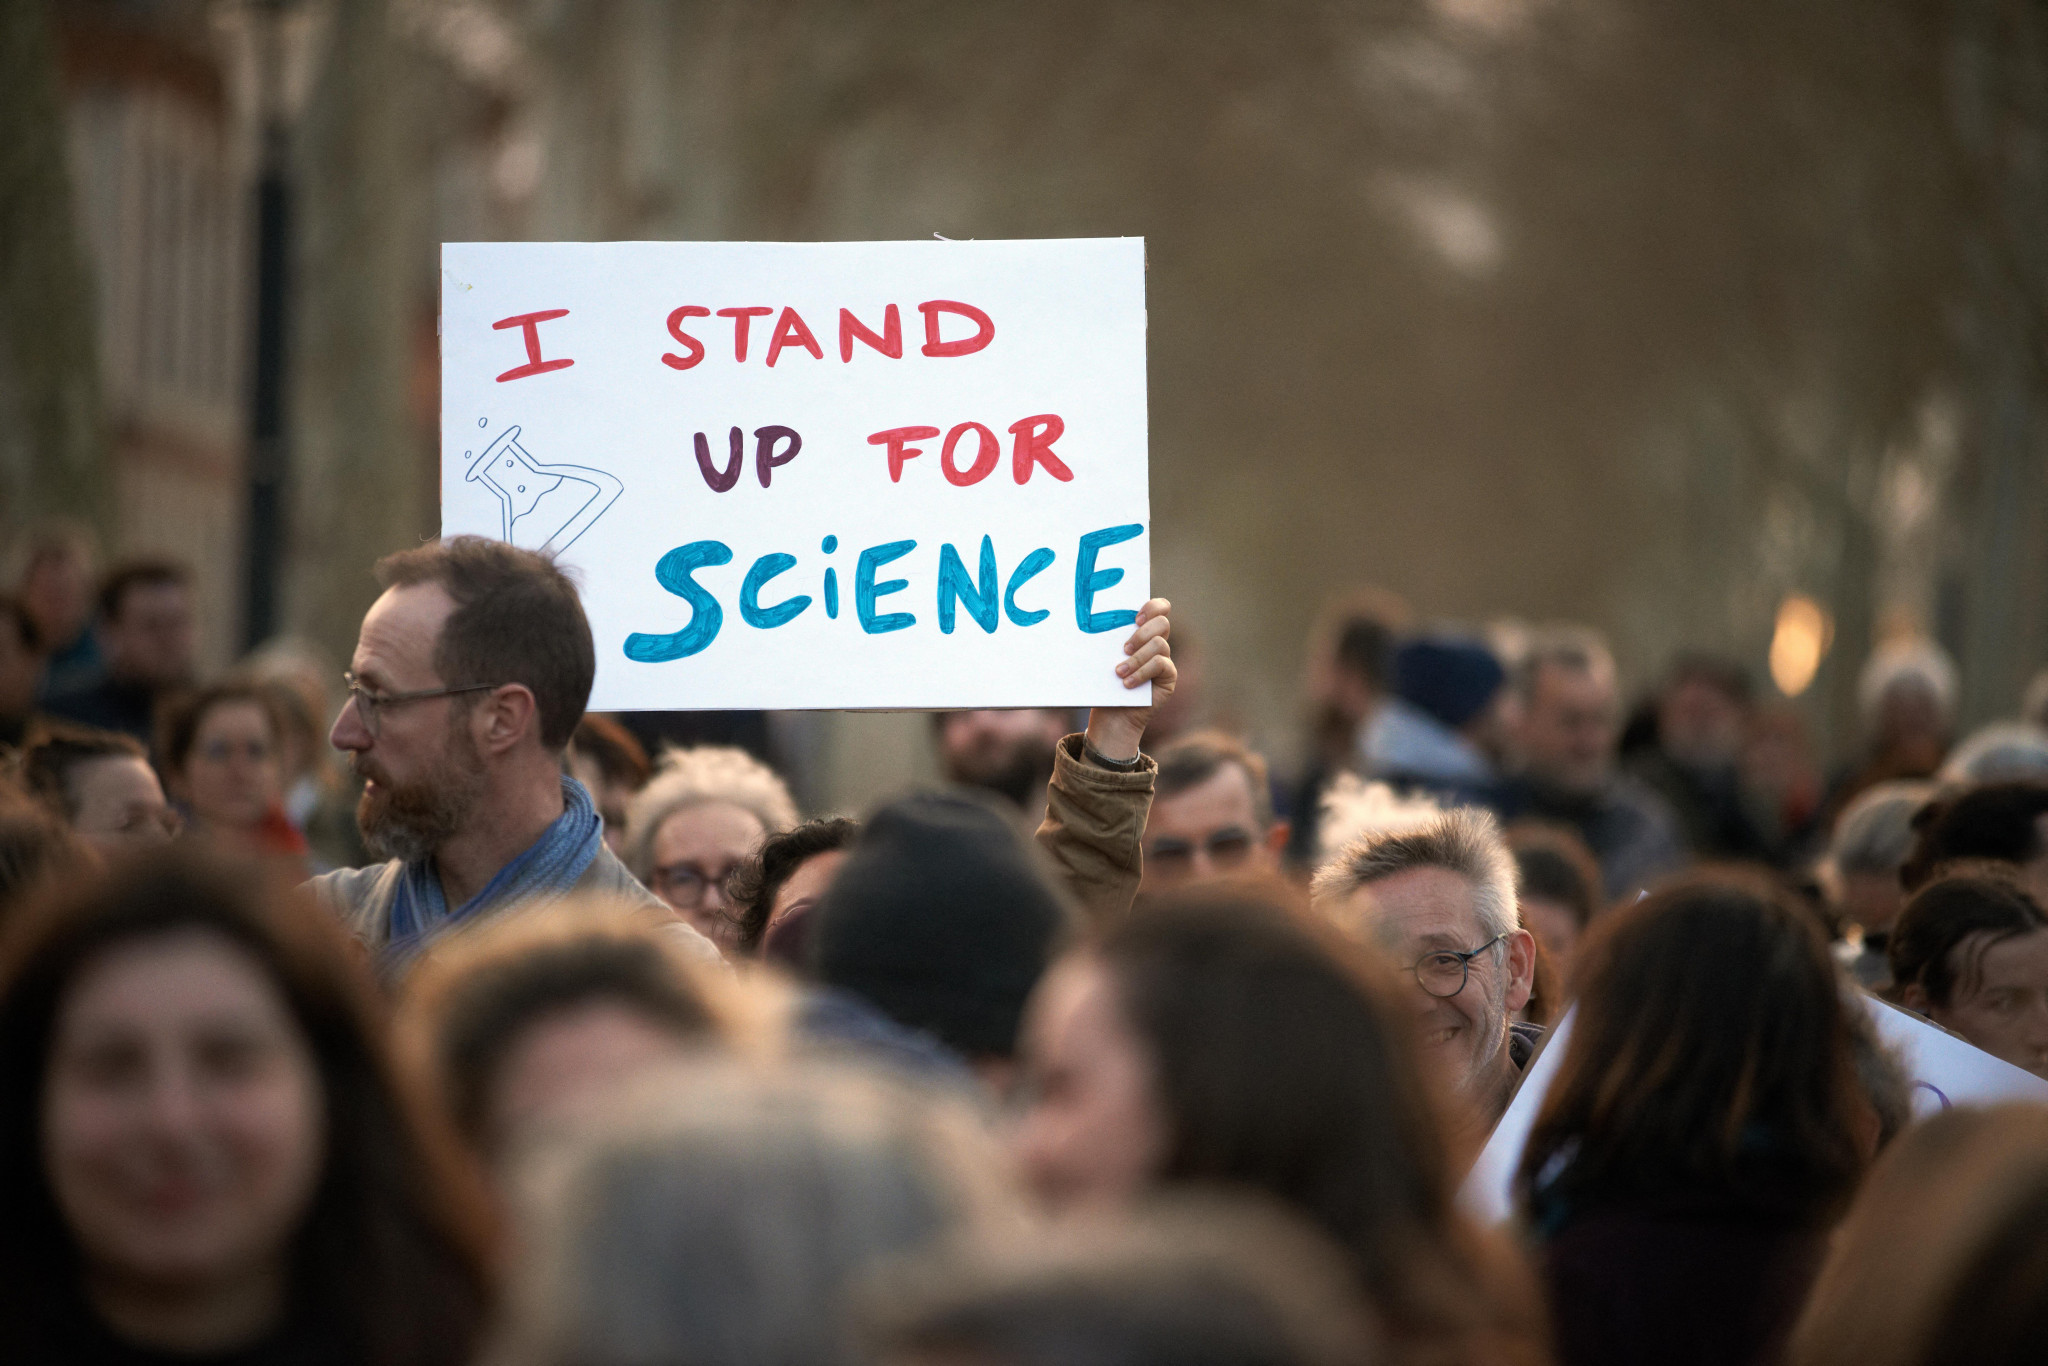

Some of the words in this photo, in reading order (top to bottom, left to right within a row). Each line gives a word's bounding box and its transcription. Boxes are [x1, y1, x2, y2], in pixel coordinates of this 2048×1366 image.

[492, 309, 574, 382] I
[661, 300, 995, 370] STAND
[694, 425, 802, 492] UP
[867, 414, 1074, 486] FOR
